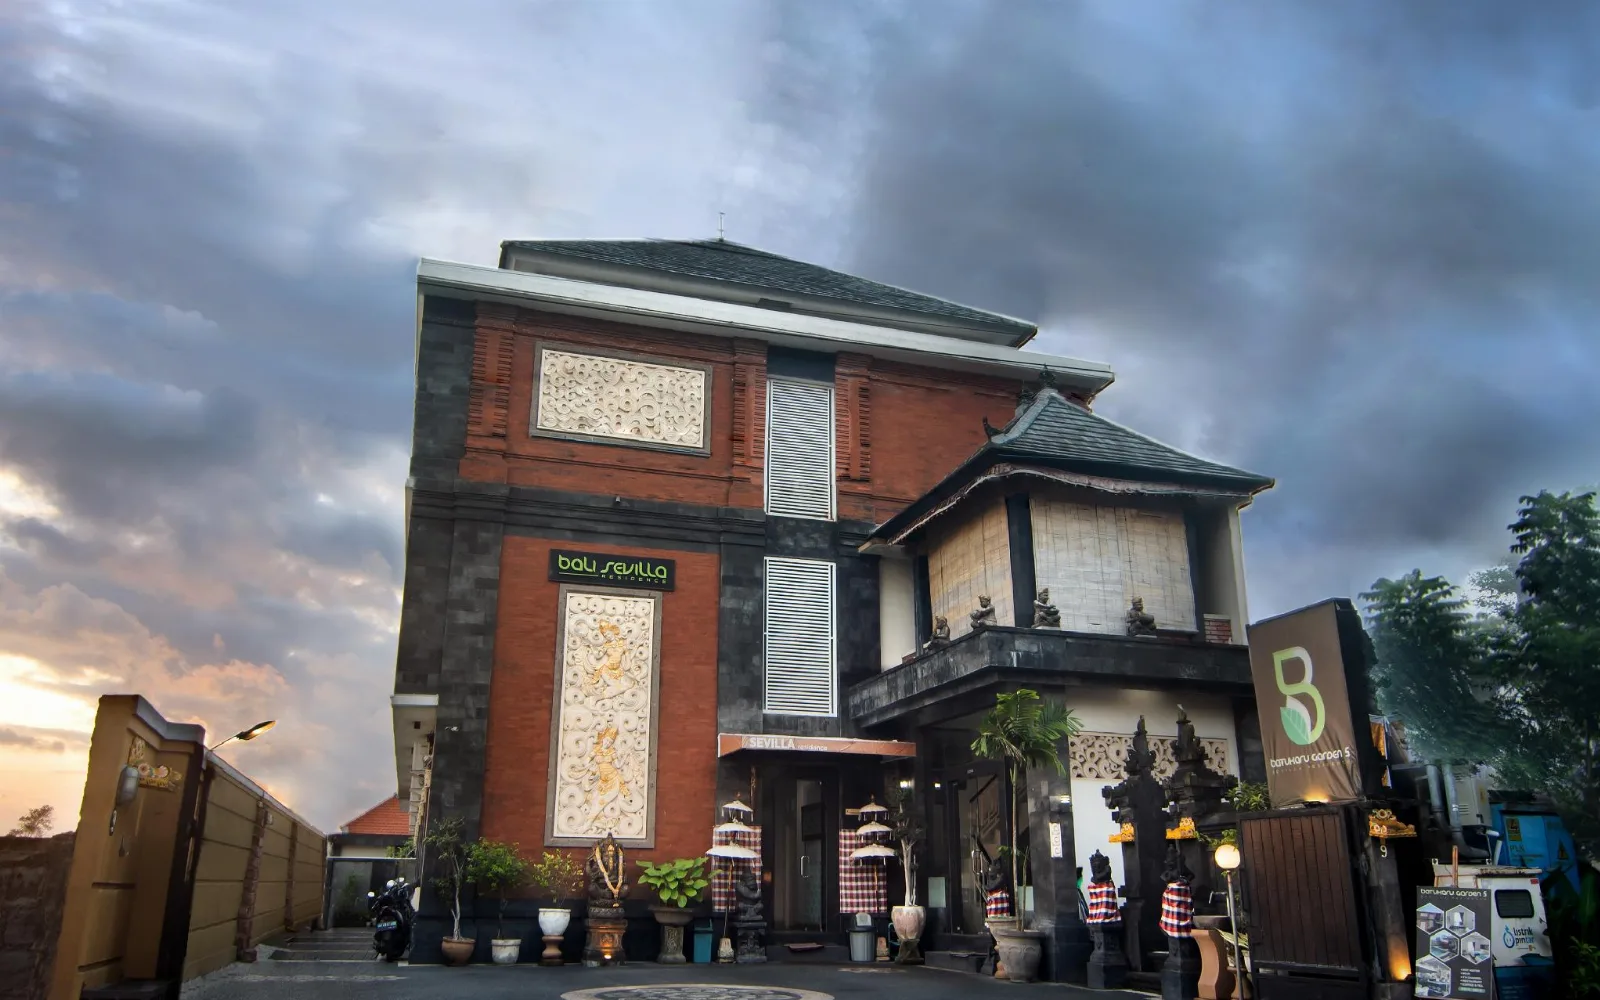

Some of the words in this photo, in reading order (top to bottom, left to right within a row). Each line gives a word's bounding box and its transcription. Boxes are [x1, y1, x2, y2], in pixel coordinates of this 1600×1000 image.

[558, 554, 596, 572] bali
[600, 561, 668, 579] sevilla
[601, 574, 667, 584] RESIDENCE
[749, 736, 796, 749] SEVILLA
[1379, 845, 1388, 858] 9
